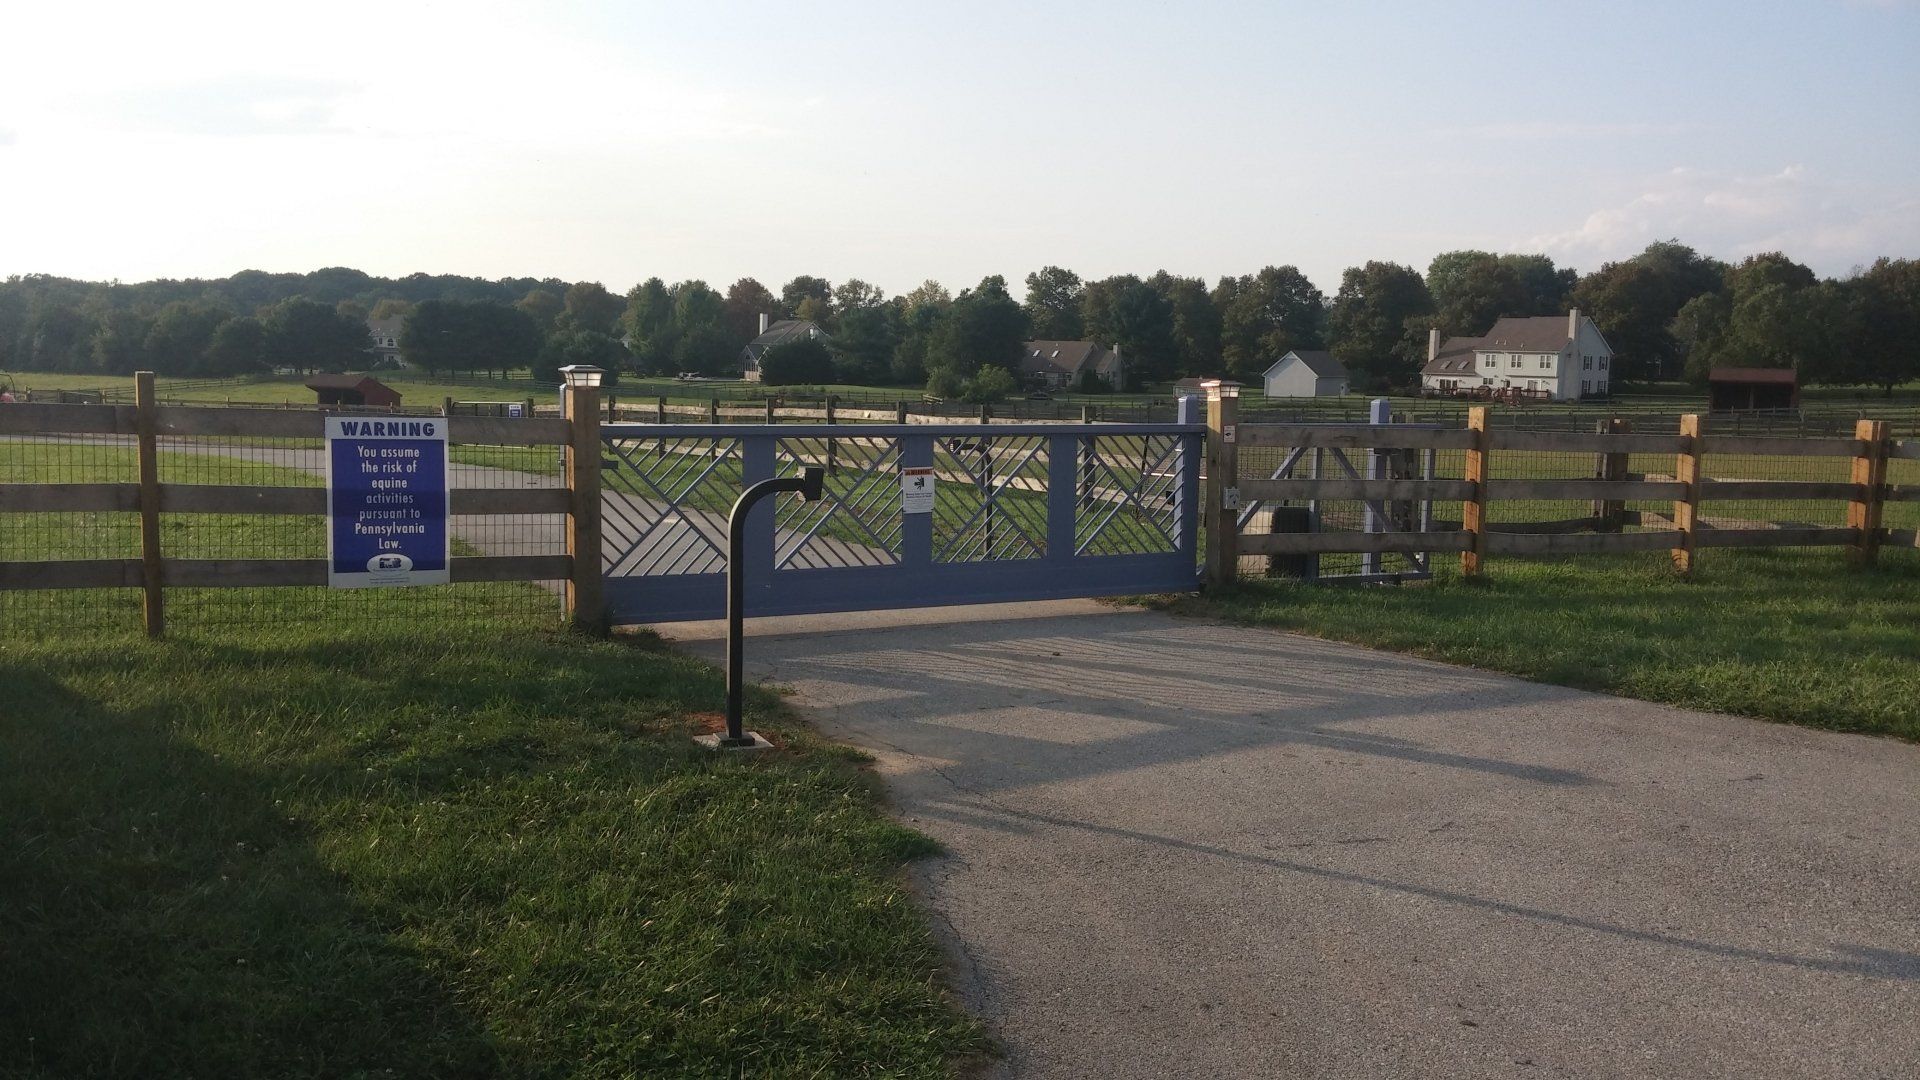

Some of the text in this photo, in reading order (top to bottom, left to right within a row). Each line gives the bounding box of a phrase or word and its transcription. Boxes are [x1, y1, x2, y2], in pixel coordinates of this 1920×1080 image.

[341, 421, 435, 437] WARNING
[357, 445, 420, 458] You assume
[361, 460, 418, 473] the risk of
[371, 477, 408, 491] equine
[366, 492, 414, 504] activities
[360, 508, 421, 521] pursuant to
[355, 521, 425, 537] Pennsylvania
[378, 538, 402, 549] Law.
